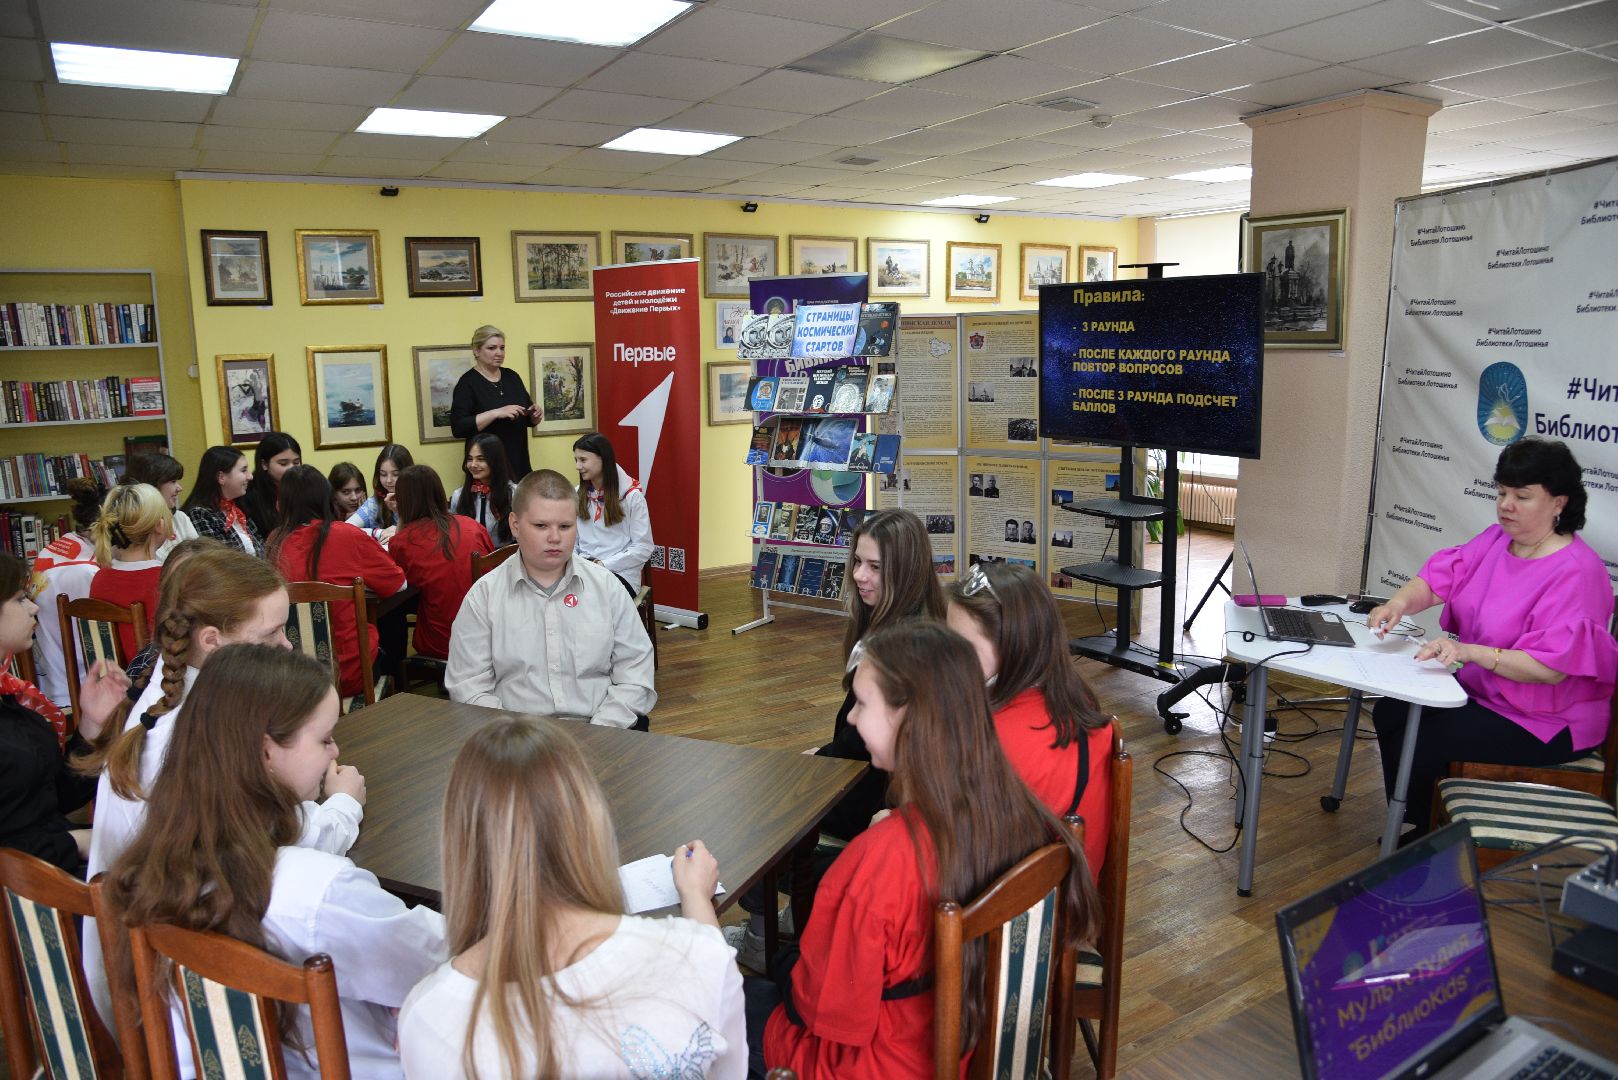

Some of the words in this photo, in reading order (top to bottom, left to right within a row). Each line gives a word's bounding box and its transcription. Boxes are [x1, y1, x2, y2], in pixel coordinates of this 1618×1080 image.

[606, 290, 646, 298] Российское
[647, 288, 686, 296] движение
[1073, 289, 1145, 307] Правила:
[1576, 304, 1617, 313] Библиотеки
[806, 311, 853, 322] СТРАНИЦЫ
[797, 324, 856, 338] КОСМИЧЕСКИХ
[1082, 322, 1088, 332] 3
[1091, 321, 1136, 333] РАУНДА
[806, 341, 844, 352] СТАРТОВ
[1476, 339, 1512, 347] Библиотеки
[614, 342, 676, 367] Первые
[1079, 349, 1115, 359] ПОСЛЕ
[1119, 349, 1176, 361] КАЖДОГО
[1180, 350, 1231, 363] РАУНДА
[1073, 362, 1116, 372] ПОВТОР
[1119, 363, 1183, 375] ВОПРОСОВ
[1079, 388, 1115, 400] ПОСЛЕ
[1118, 390, 1124, 400] 3
[1127, 390, 1173, 405] РАУНДА
[1177, 393, 1238, 407] ПОДСЧЕТ
[1073, 402, 1116, 413] БАЛЛОВ
